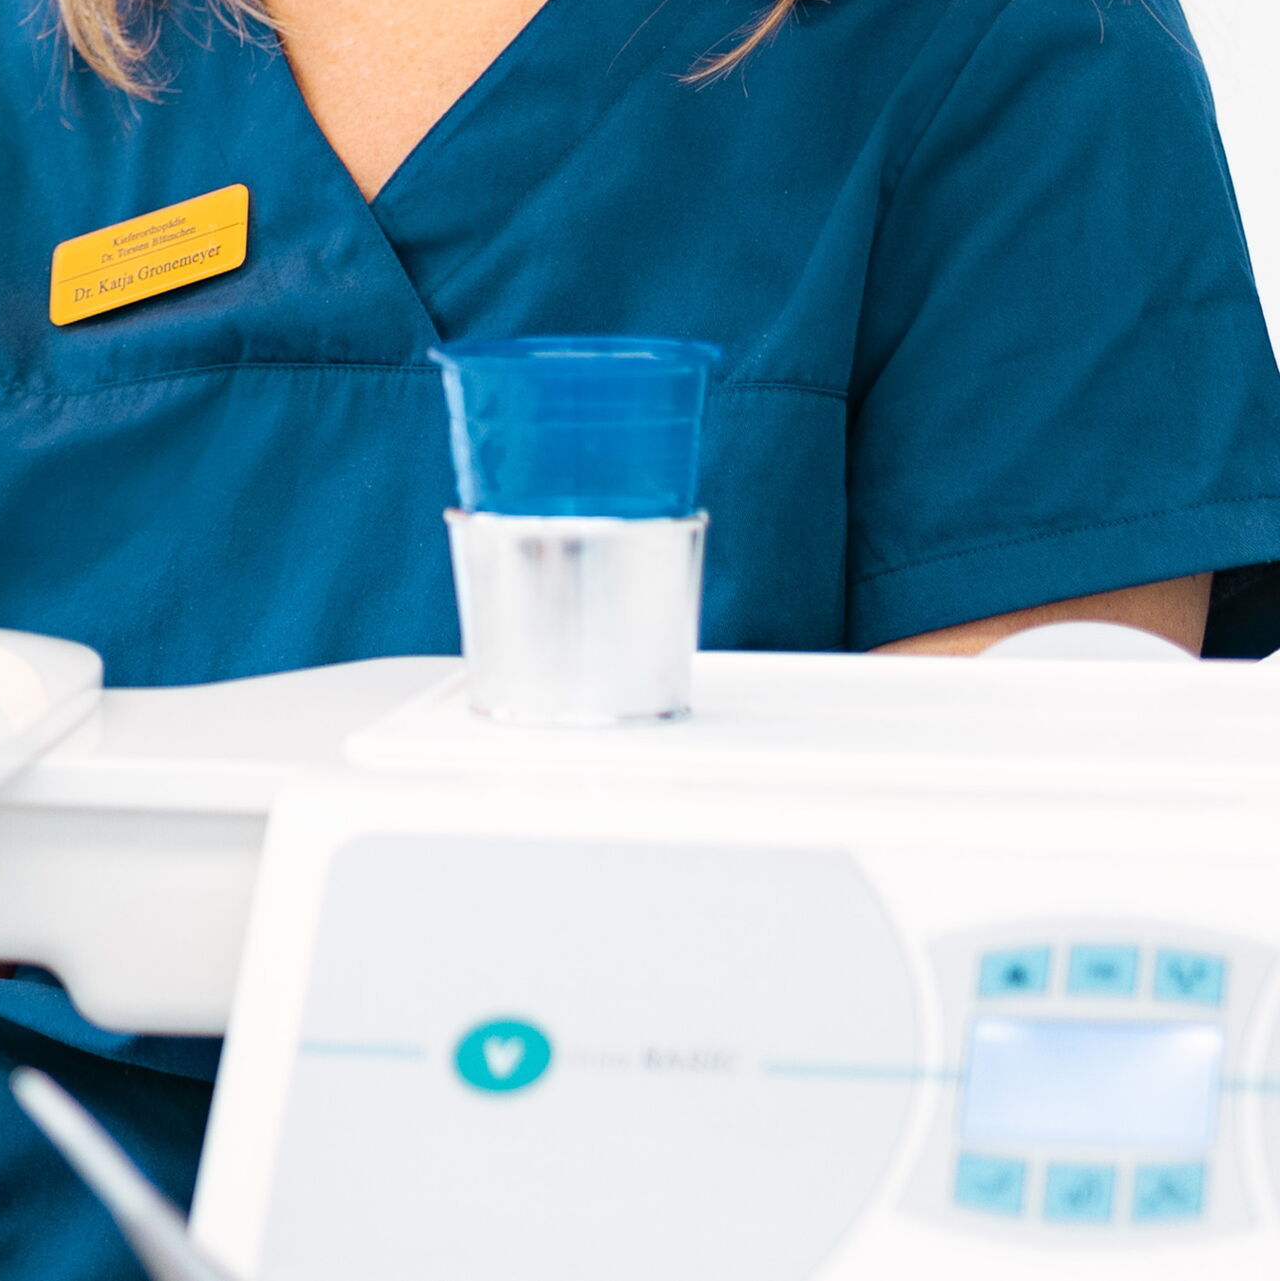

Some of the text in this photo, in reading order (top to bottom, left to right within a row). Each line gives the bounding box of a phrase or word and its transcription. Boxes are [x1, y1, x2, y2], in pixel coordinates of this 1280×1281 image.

[73, 245, 222, 303] Dr. Katja Gronemeyer
